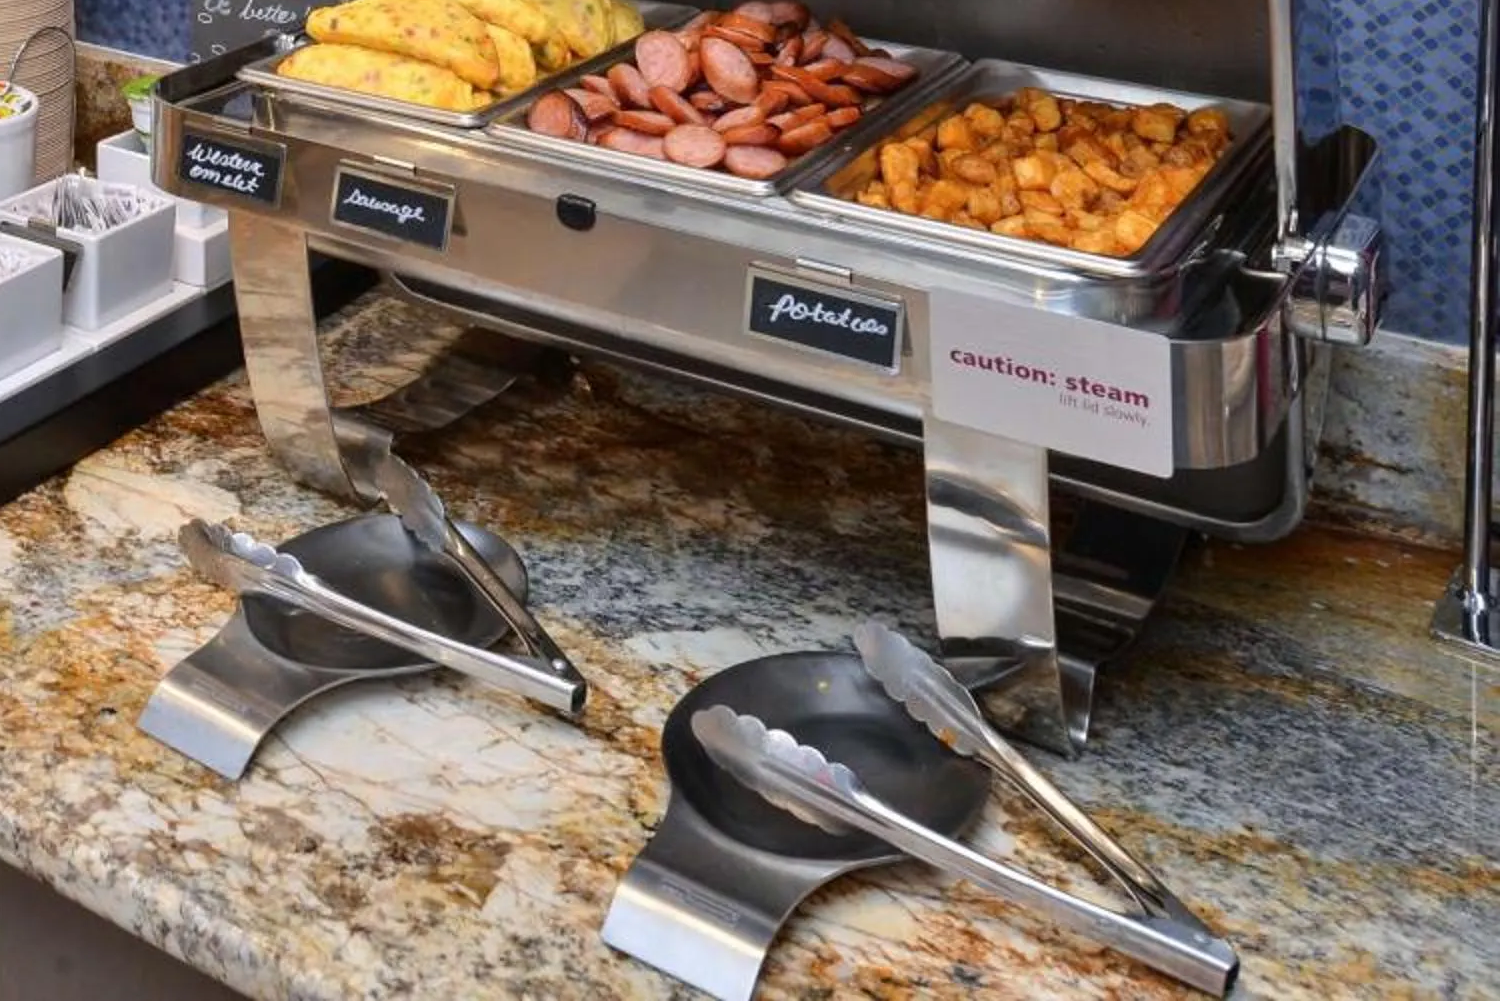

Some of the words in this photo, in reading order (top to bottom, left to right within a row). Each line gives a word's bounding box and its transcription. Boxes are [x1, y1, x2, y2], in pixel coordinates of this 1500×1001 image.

[950, 349, 1056, 387] caution:
[1064, 375, 1150, 409] steam
[1103, 405, 1151, 427] slowly.
